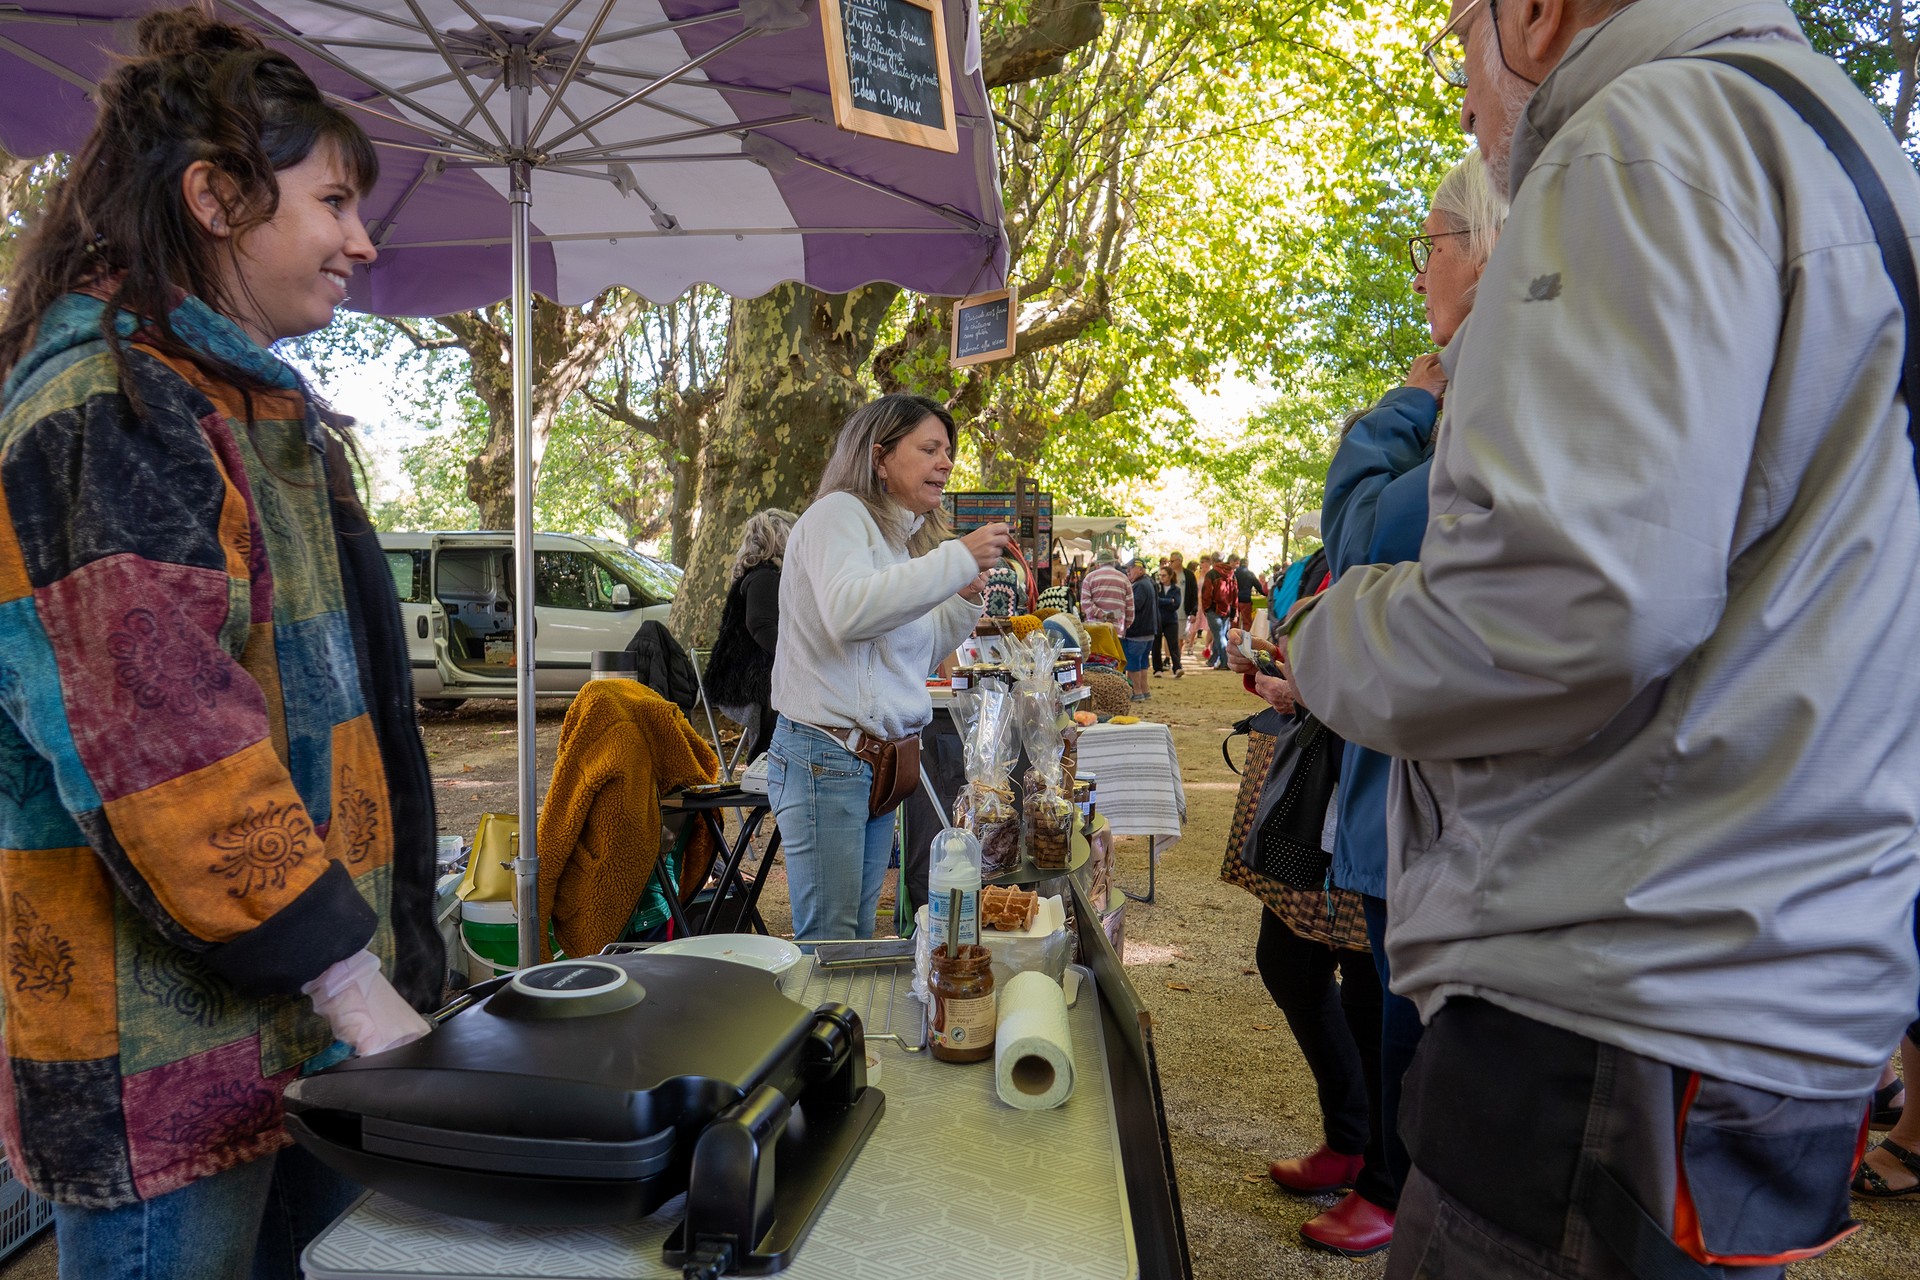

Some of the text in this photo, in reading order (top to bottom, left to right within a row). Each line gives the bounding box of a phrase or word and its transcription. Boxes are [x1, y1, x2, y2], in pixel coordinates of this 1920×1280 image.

[845, 8, 926, 52] Chips à la farine
[851, 77, 921, 116] Idées CADEAUX
